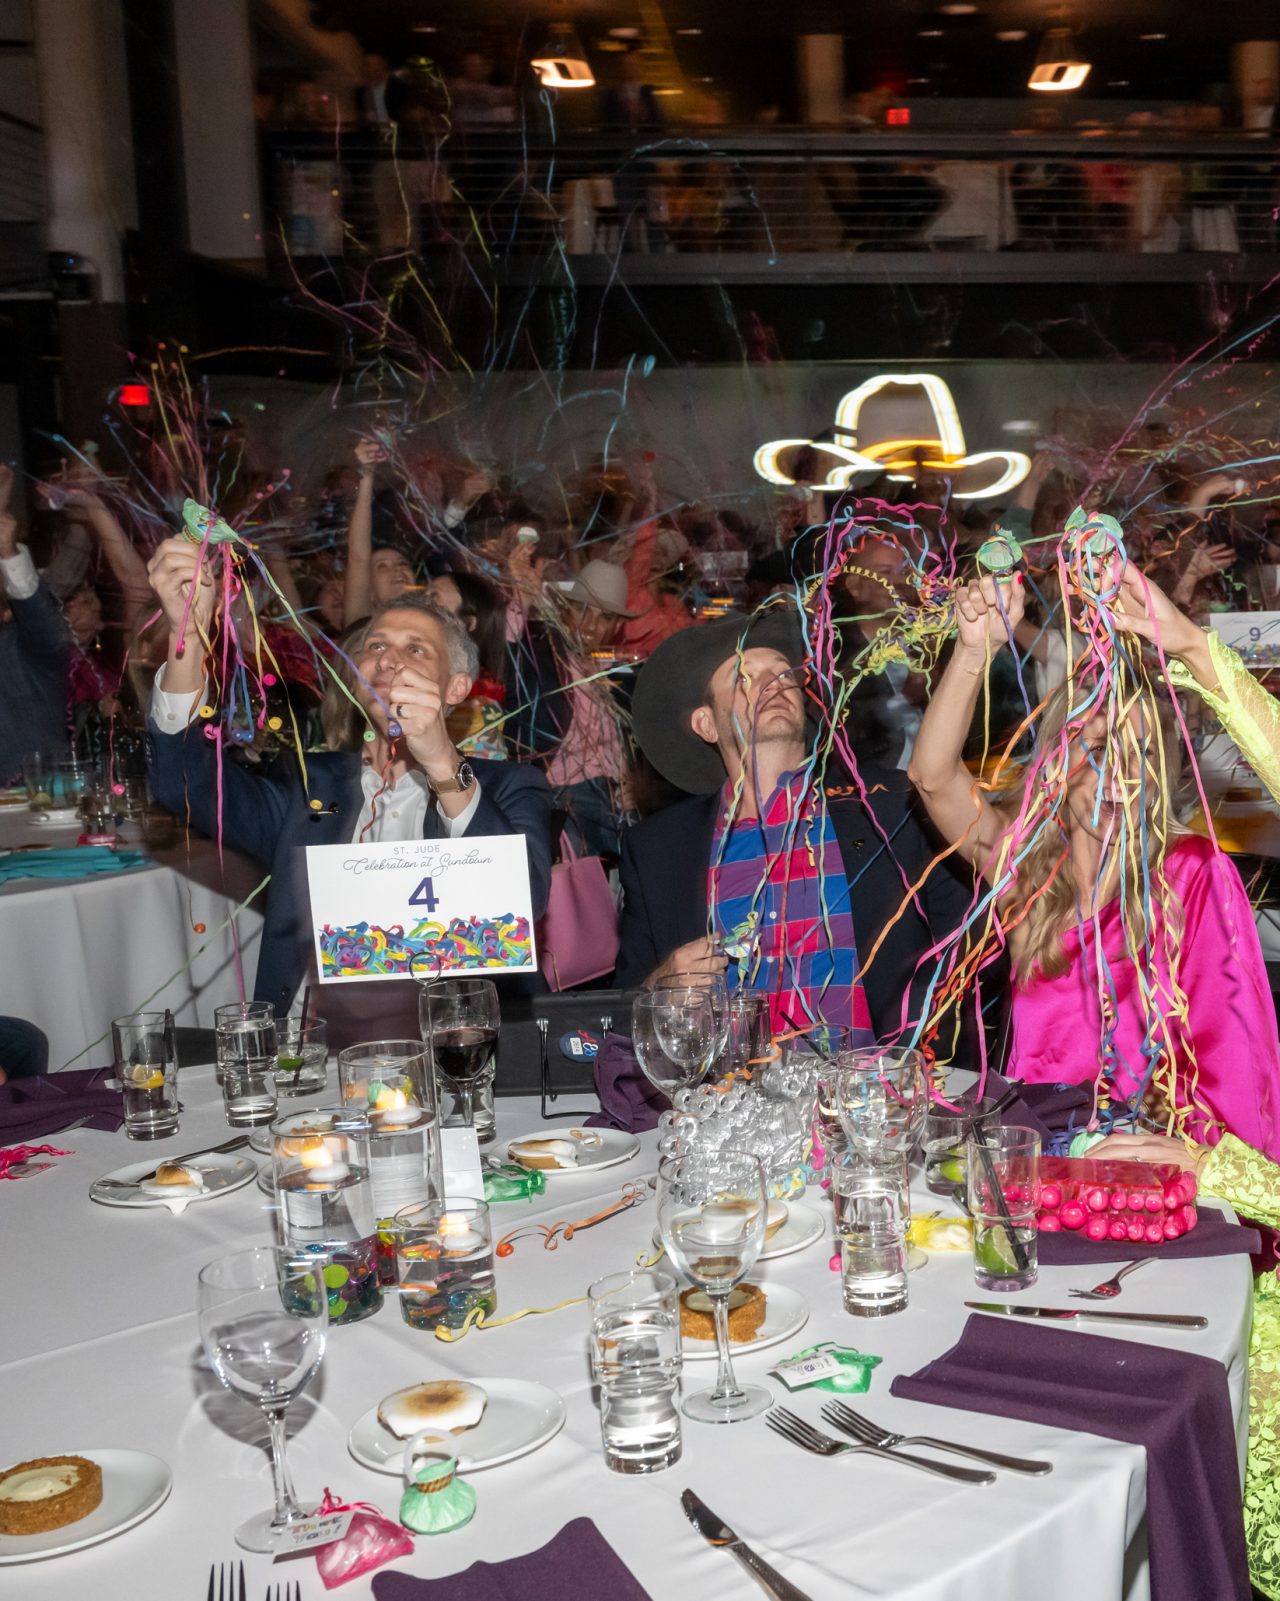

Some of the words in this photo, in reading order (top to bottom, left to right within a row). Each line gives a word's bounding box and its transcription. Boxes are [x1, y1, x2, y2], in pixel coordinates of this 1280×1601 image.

[1250, 627, 1261, 641] 9
[393, 846, 409, 855] ST.
[414, 844, 440, 854] JUDE
[343, 857, 418, 875] Celebration
[420, 856, 431, 868] at
[431, 849, 492, 877] Sundown
[408, 876, 439, 913] 4
